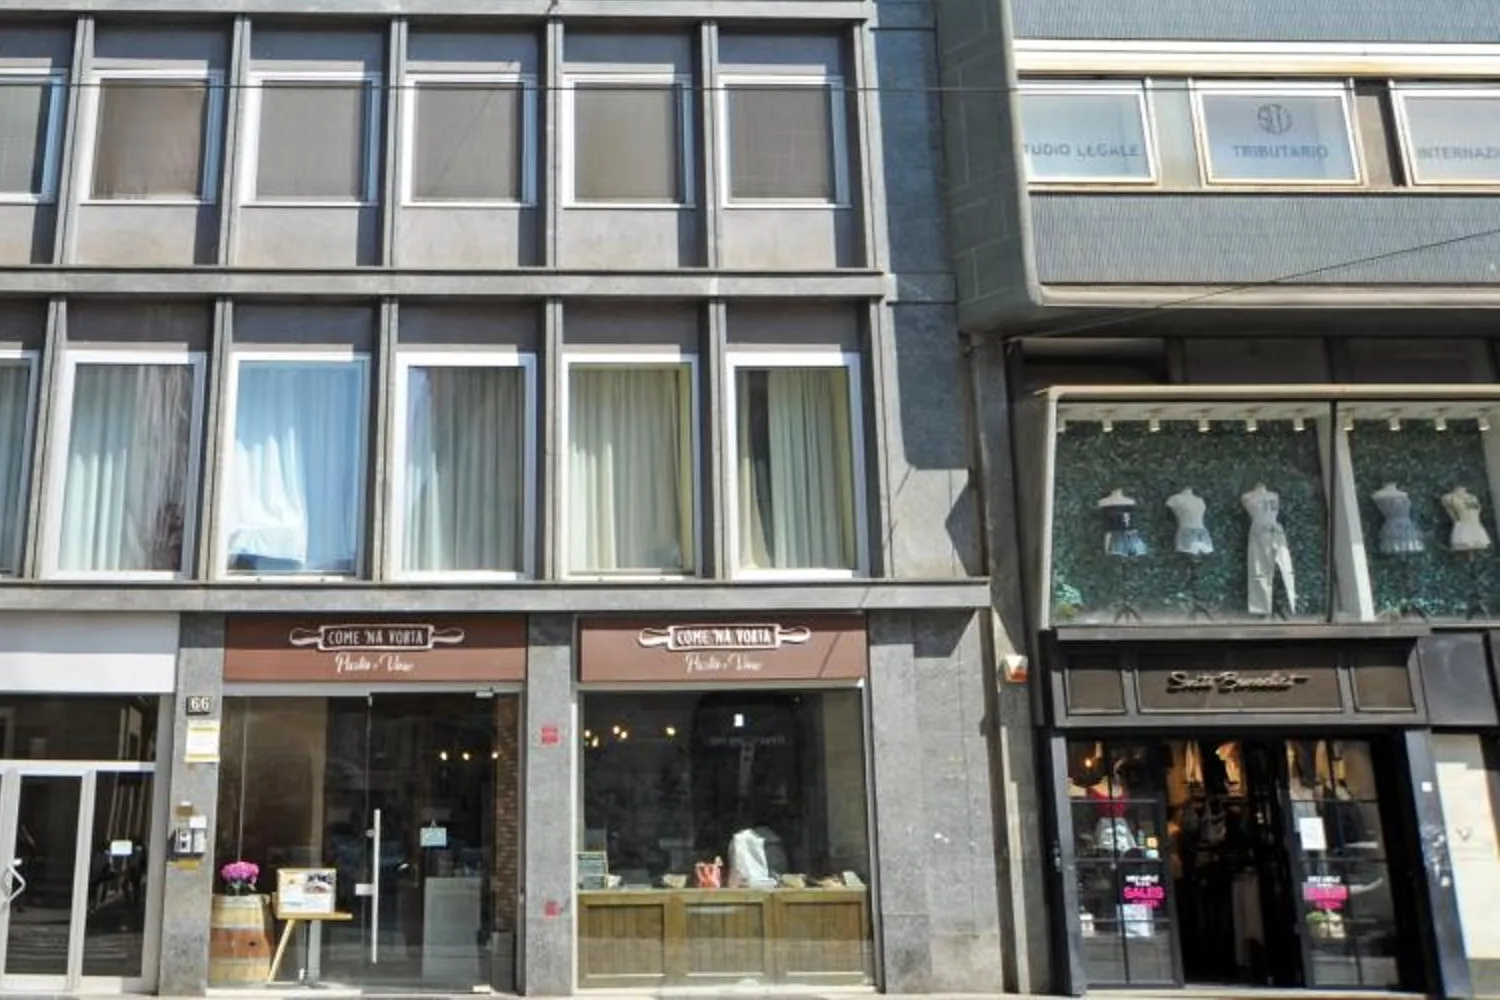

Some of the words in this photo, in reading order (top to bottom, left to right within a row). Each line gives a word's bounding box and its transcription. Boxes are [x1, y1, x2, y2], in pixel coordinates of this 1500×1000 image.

[1024, 143, 1071, 156] TUDIO
[1076, 144, 1140, 158] LEGALE
[1232, 144, 1329, 158] TRIBUTARIO
[328, 630, 359, 645] COME
[388, 630, 423, 645] VORTA
[677, 630, 708, 645] COME
[738, 629, 772, 643] VORTA
[191, 698, 209, 710] 66
